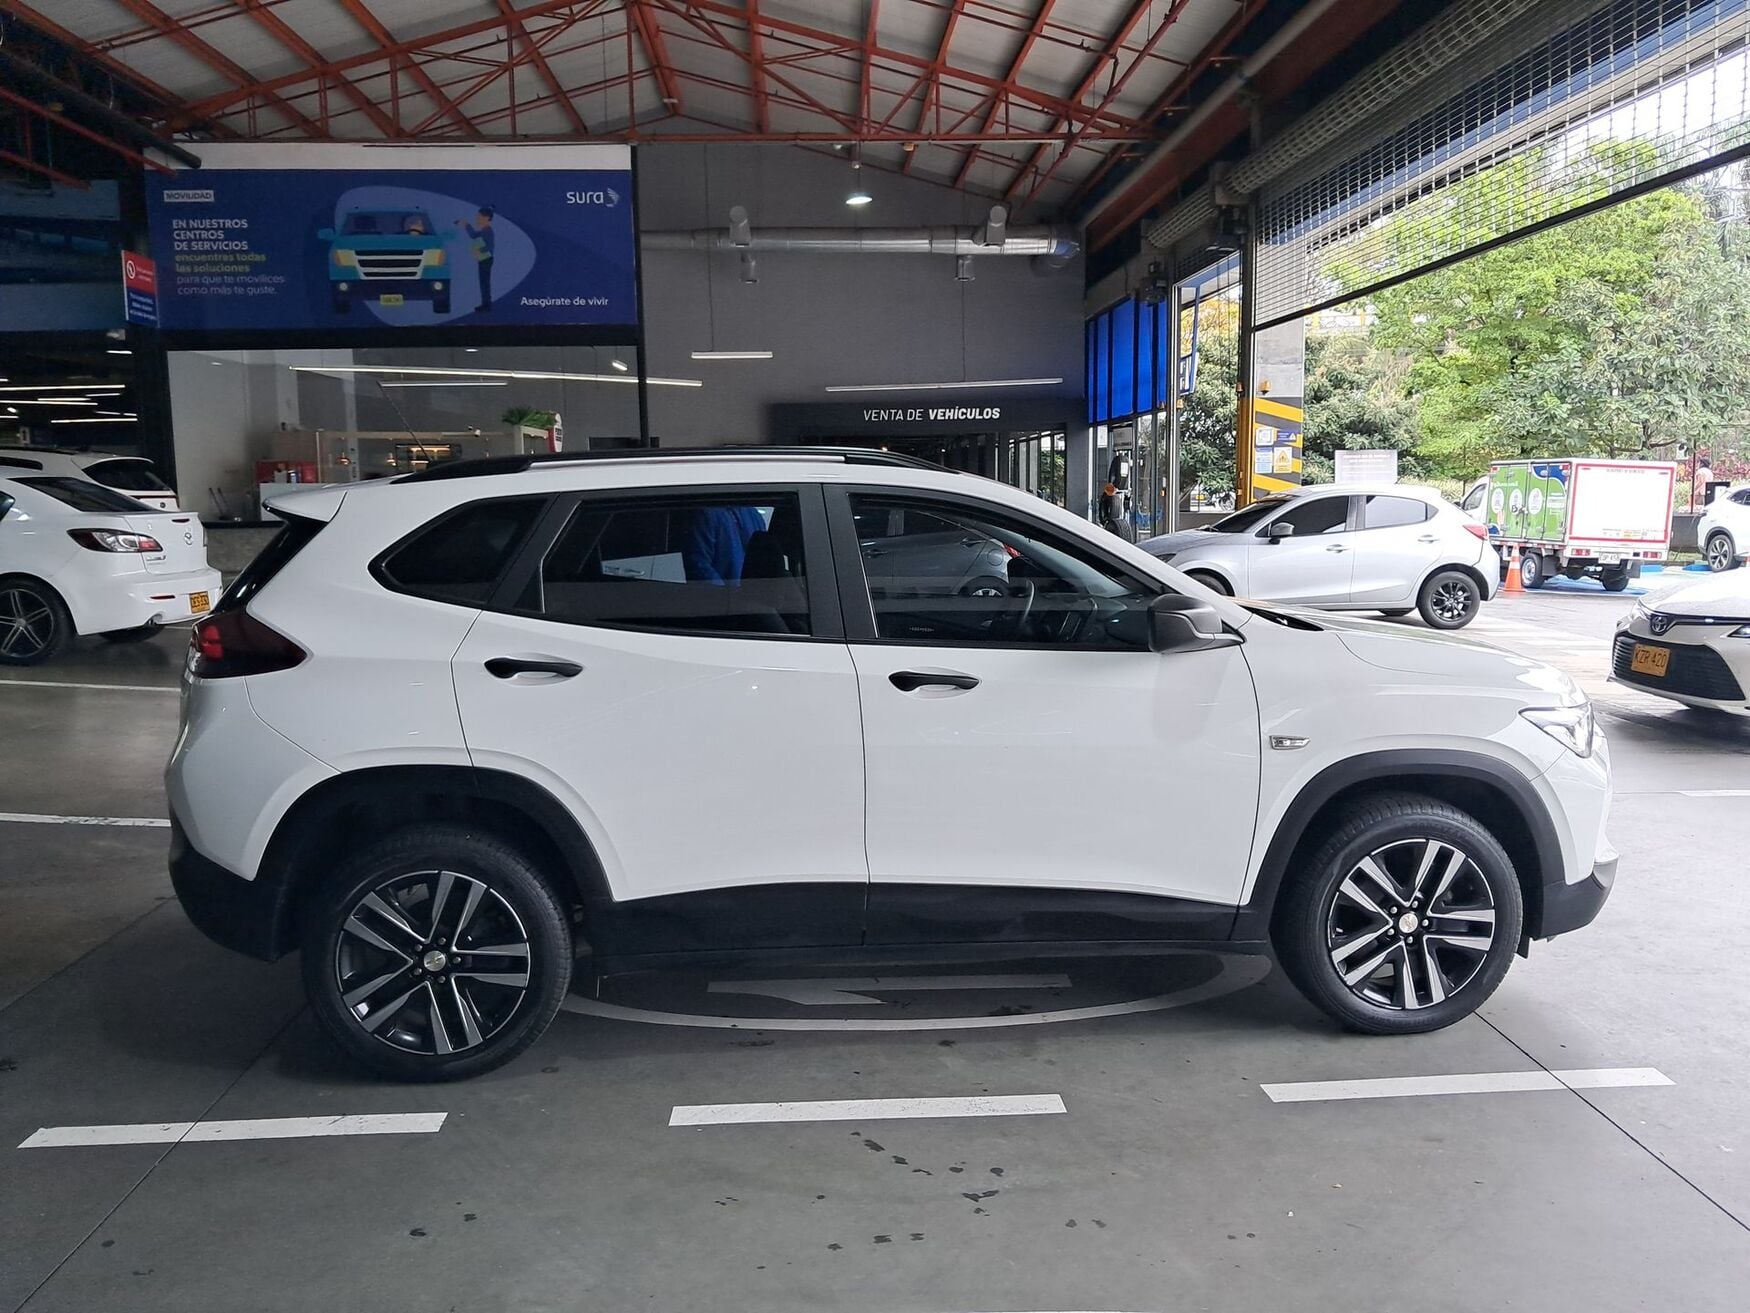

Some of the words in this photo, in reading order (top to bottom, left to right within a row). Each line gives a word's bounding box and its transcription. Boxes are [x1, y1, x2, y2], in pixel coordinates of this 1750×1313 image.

[166, 192, 212, 200] MOVILIDAD
[566, 191, 604, 204] sura
[172, 219, 187, 229] EN
[189, 219, 248, 229] NUESTROS
[173, 230, 225, 240] CENTROS
[174, 241, 188, 251] DE
[191, 241, 248, 251] SERVICIOS
[236, 252, 267, 262] todas
[194, 263, 251, 273] soluciones
[520, 296, 571, 308] Asegúrate
[573, 296, 586, 306] de
[587, 296, 609, 306] vivir
[863, 409, 904, 421] VENTA
[907, 409, 924, 421] DE
[928, 406, 1001, 420] VEHÍCULOS
[1651, 651, 1668, 667] 420
